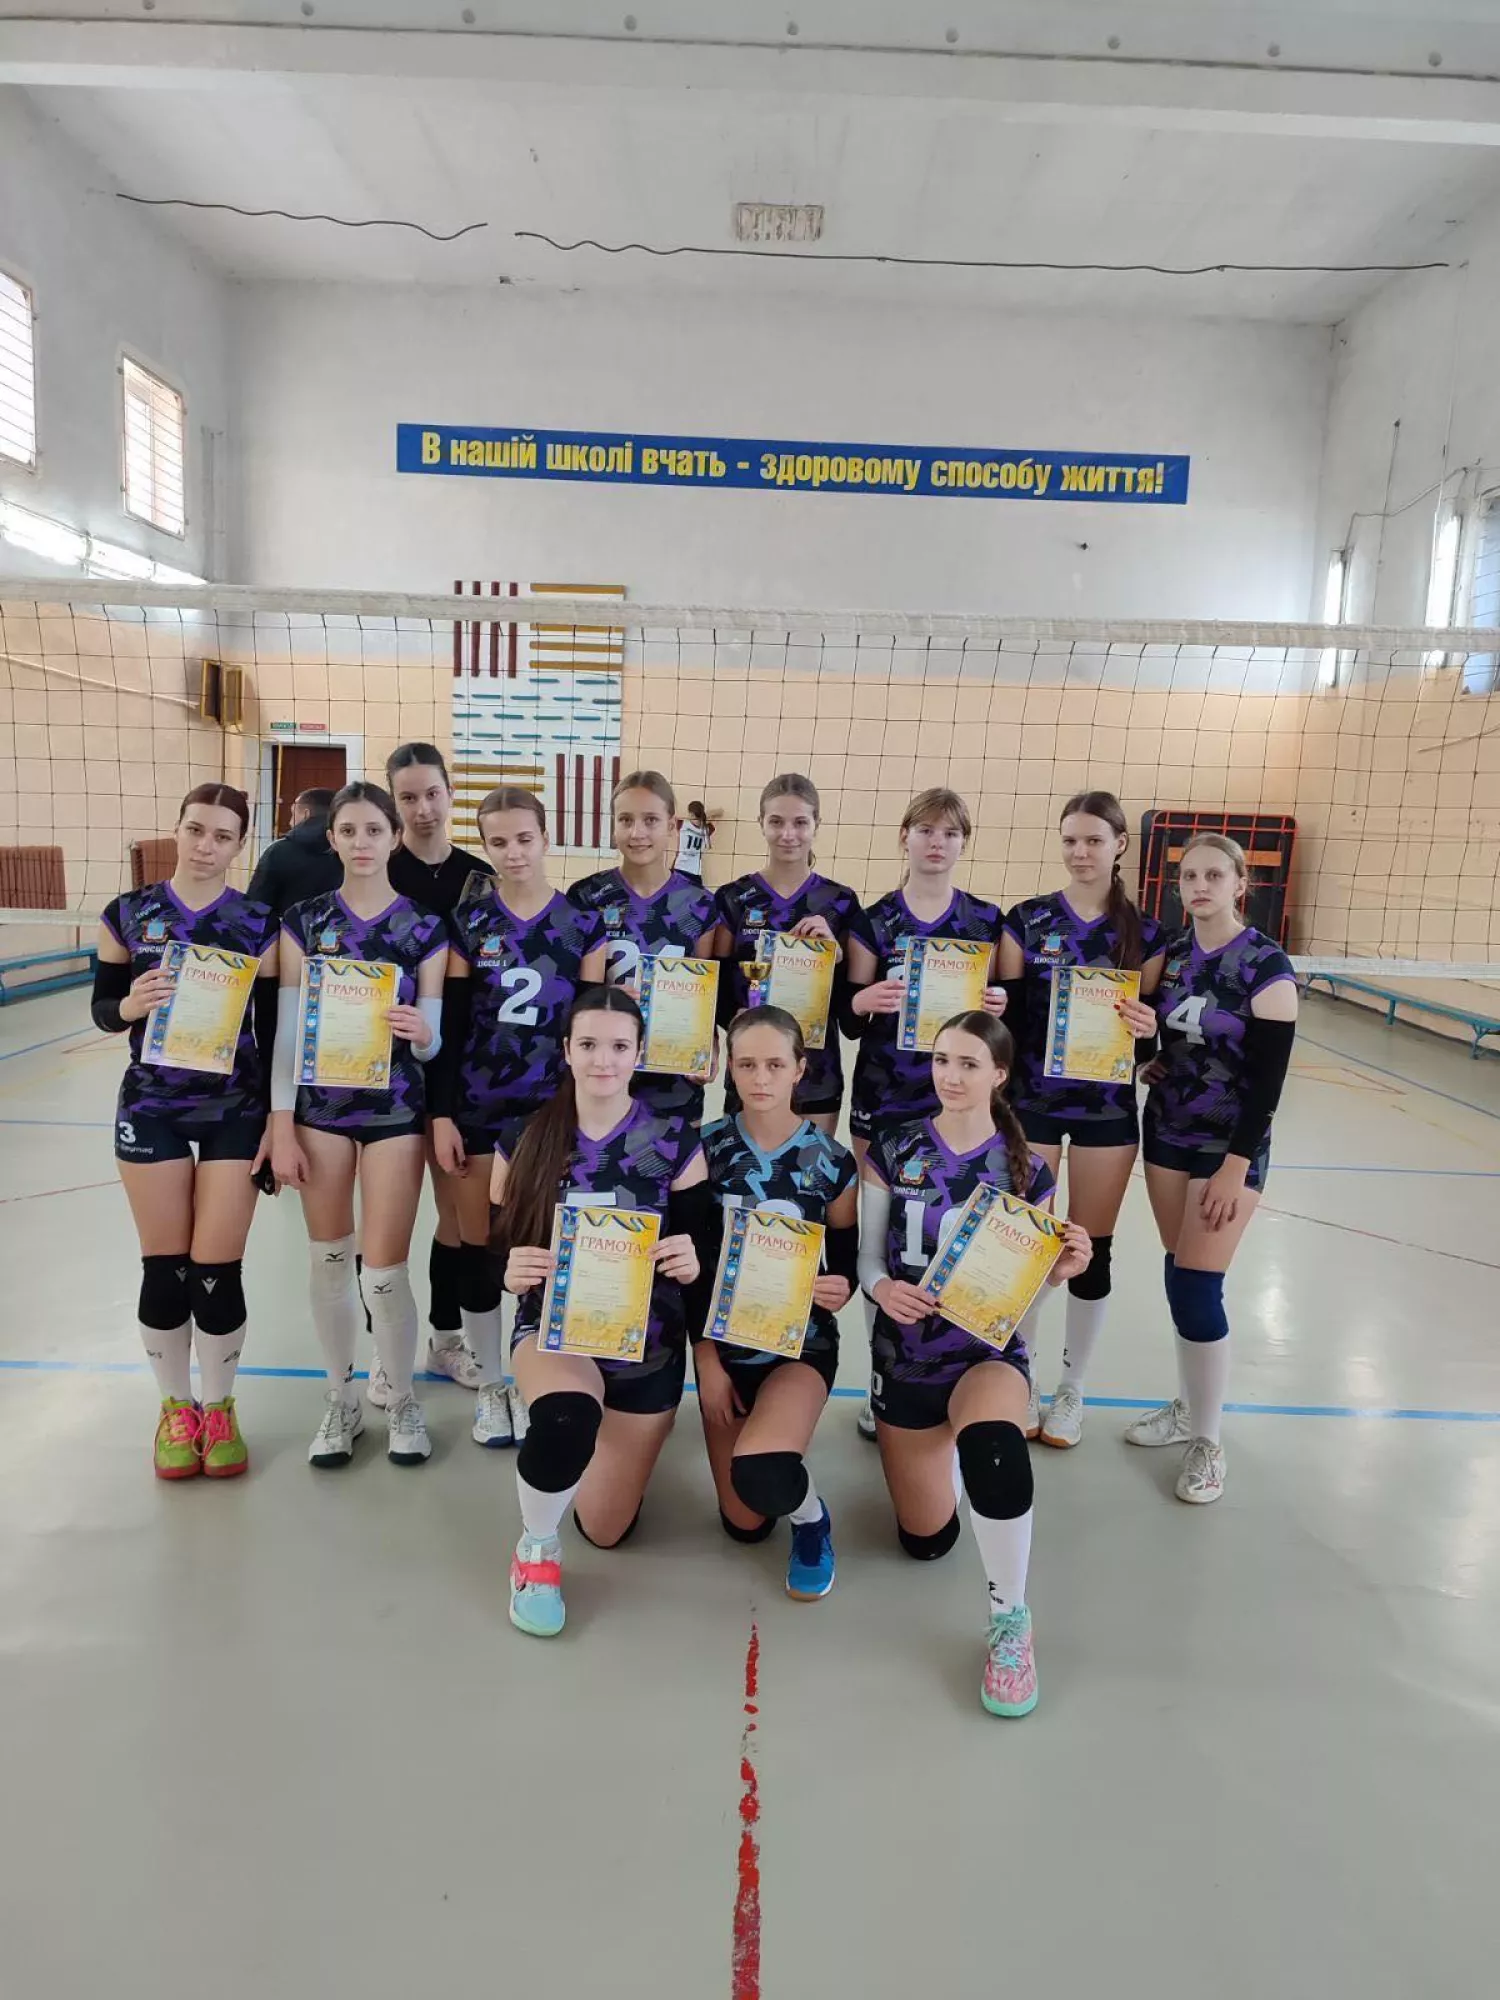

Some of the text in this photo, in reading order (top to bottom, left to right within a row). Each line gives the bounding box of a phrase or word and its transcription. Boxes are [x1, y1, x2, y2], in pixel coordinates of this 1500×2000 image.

[421, 431, 1164, 496] В нашій школі вчать - здоровому способу життя!
[686, 835, 703, 850] 14
[776, 956, 828, 971] ГРАМОТА
[928, 959, 978, 971] ГРАМОТА
[183, 966, 240, 987] ГРАМОТА
[326, 984, 383, 998] ГРАМОТА
[497, 967, 542, 1026] 2
[656, 980, 707, 996] ГРАМОТА
[1074, 987, 1128, 1000] ГРАМОТА
[1165, 995, 1208, 1046] 4
[118, 1121, 136, 1144] 3
[580, 1235, 642, 1255] ГРАМОТА
[749, 1233, 808, 1255] ГРАМОТА
[987, 1216, 1045, 1256] ГРАМОТА
